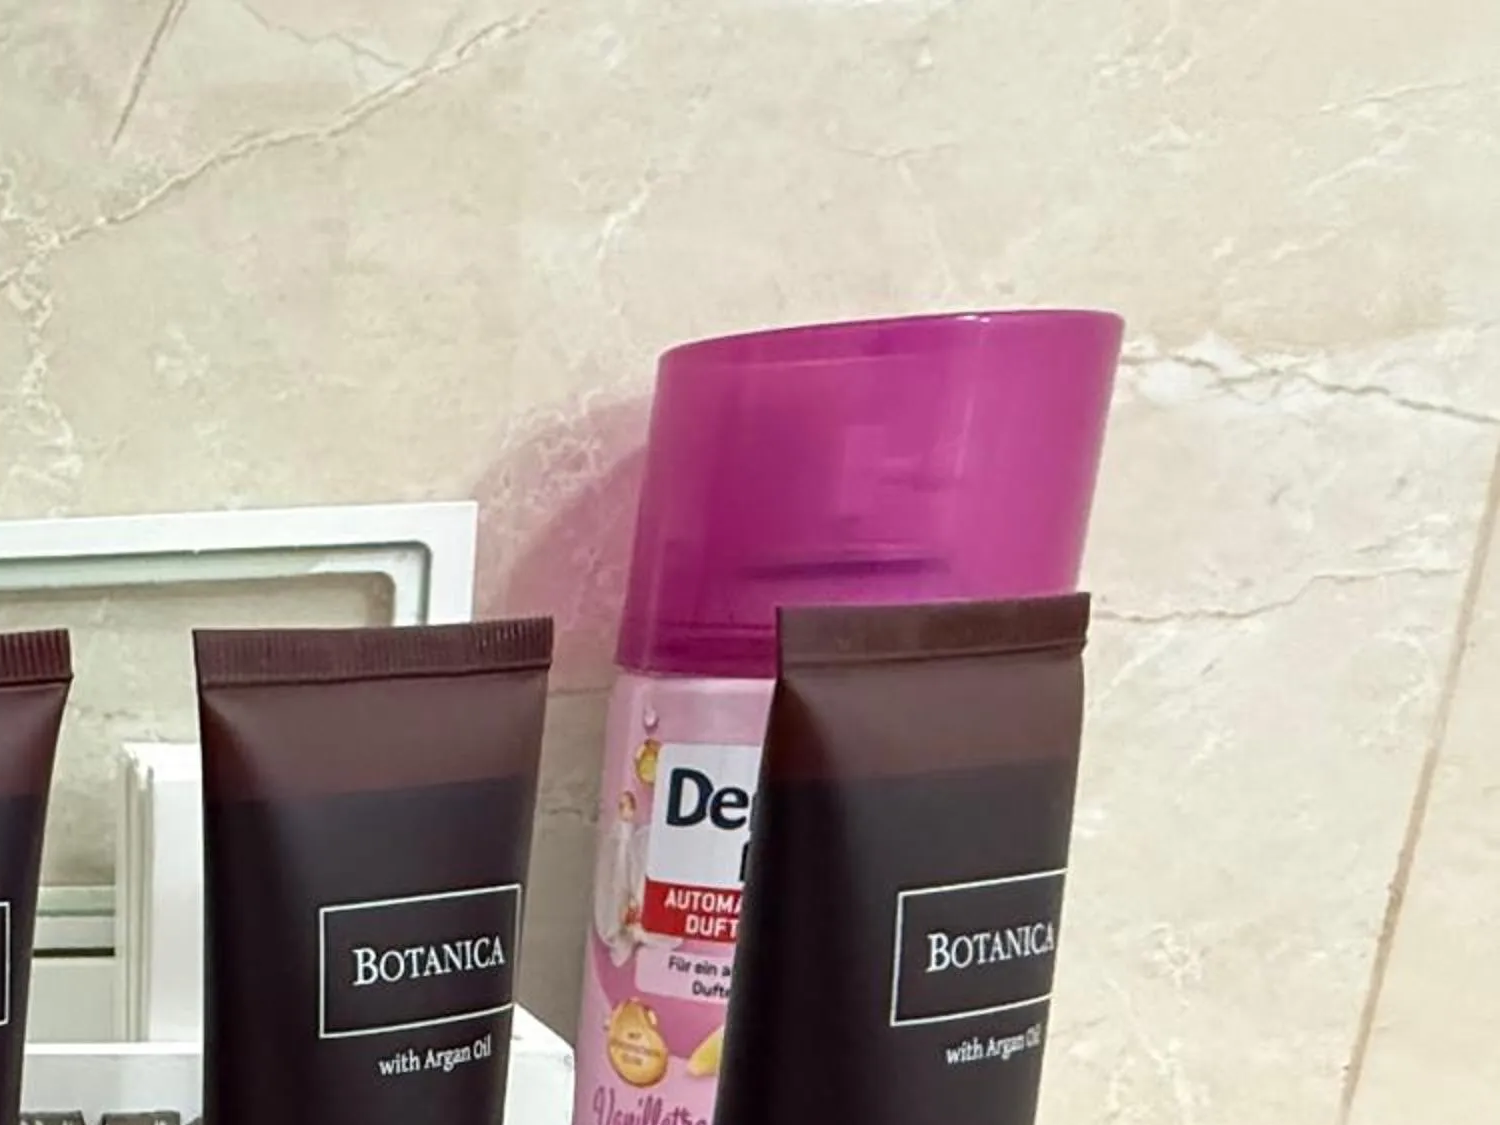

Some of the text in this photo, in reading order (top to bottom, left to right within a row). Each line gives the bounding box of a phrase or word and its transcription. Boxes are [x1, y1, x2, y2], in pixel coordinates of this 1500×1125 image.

[666, 767, 755, 830] De
[352, 934, 505, 986] BOTANICA
[668, 955, 691, 972] Für
[694, 960, 718, 976] ein
[925, 921, 1055, 973] BOTANICA
[378, 1033, 491, 1076] with Argan Oil
[946, 1036, 984, 1064] with
[986, 1034, 1025, 1061] Argan
